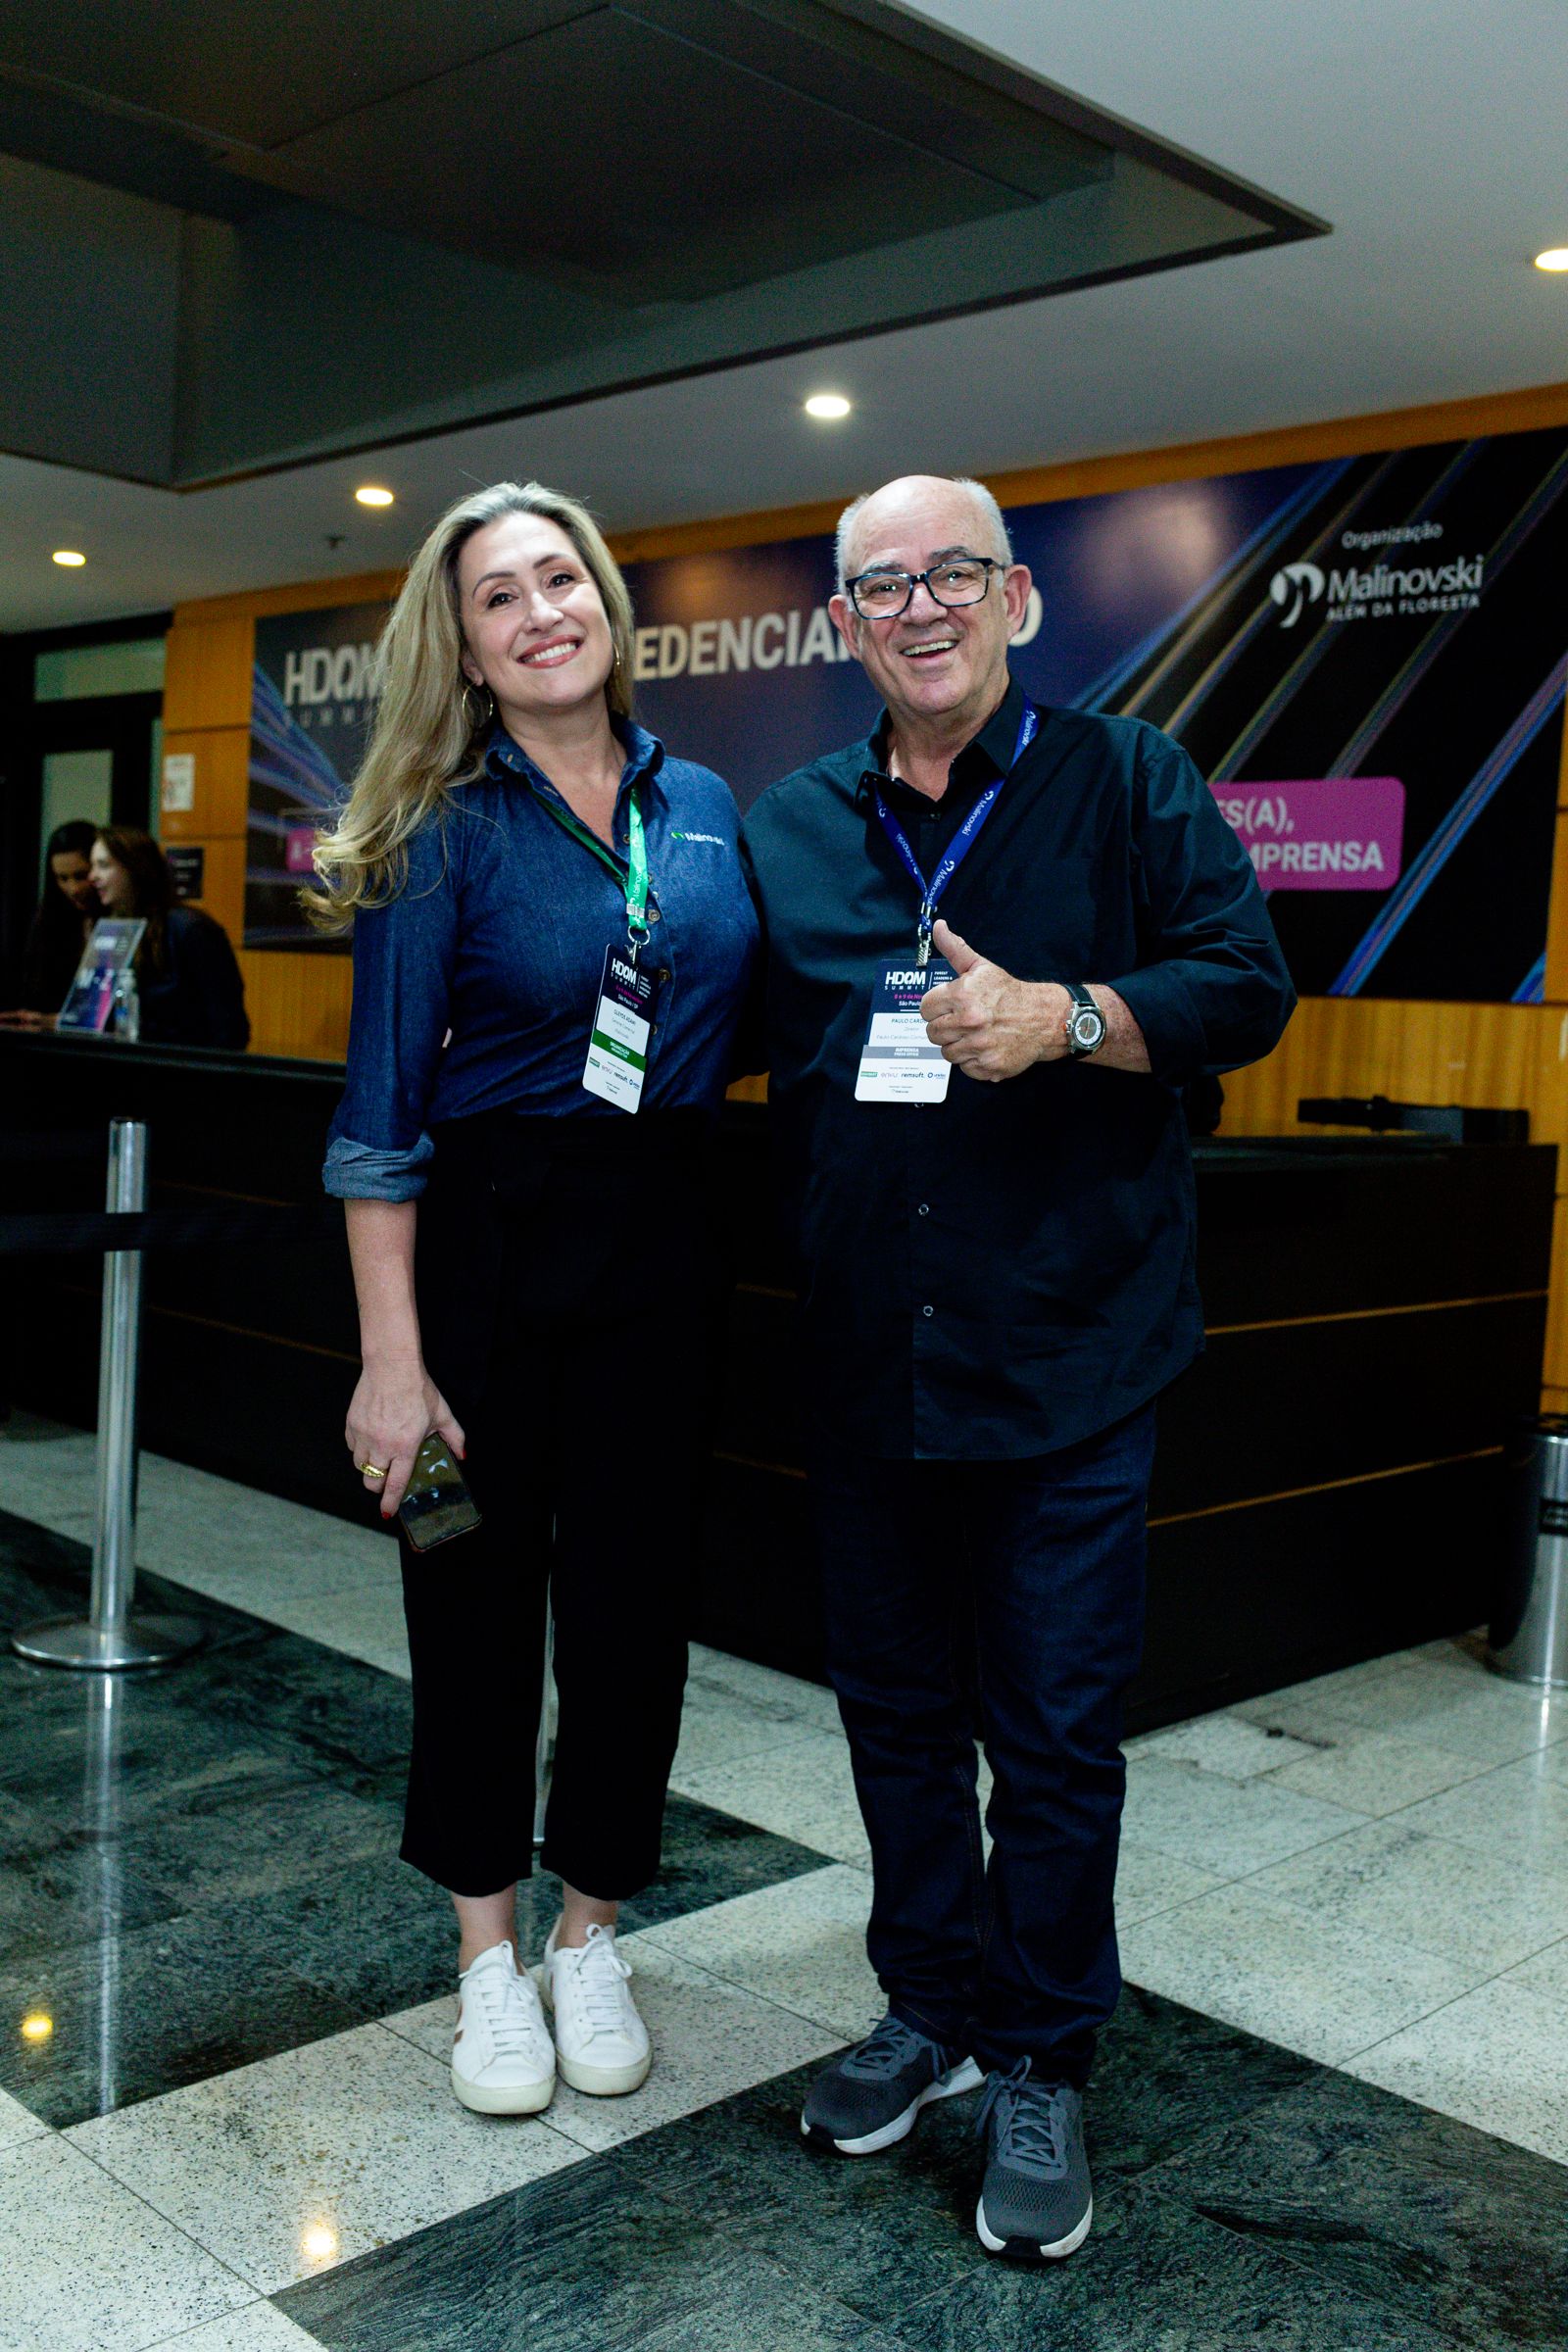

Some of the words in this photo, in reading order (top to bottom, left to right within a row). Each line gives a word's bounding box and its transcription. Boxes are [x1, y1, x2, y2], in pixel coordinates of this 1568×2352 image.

[1342, 520, 1444, 550] Organização
[1327, 554, 1484, 603] Malinovski
[1373, 602, 1394, 618] DA
[1398, 593, 1481, 614] FLORESTA
[961, 800, 988, 836] Malinovski
[611, 957, 637, 985] HDOM
[885, 971, 926, 985] HDOM
